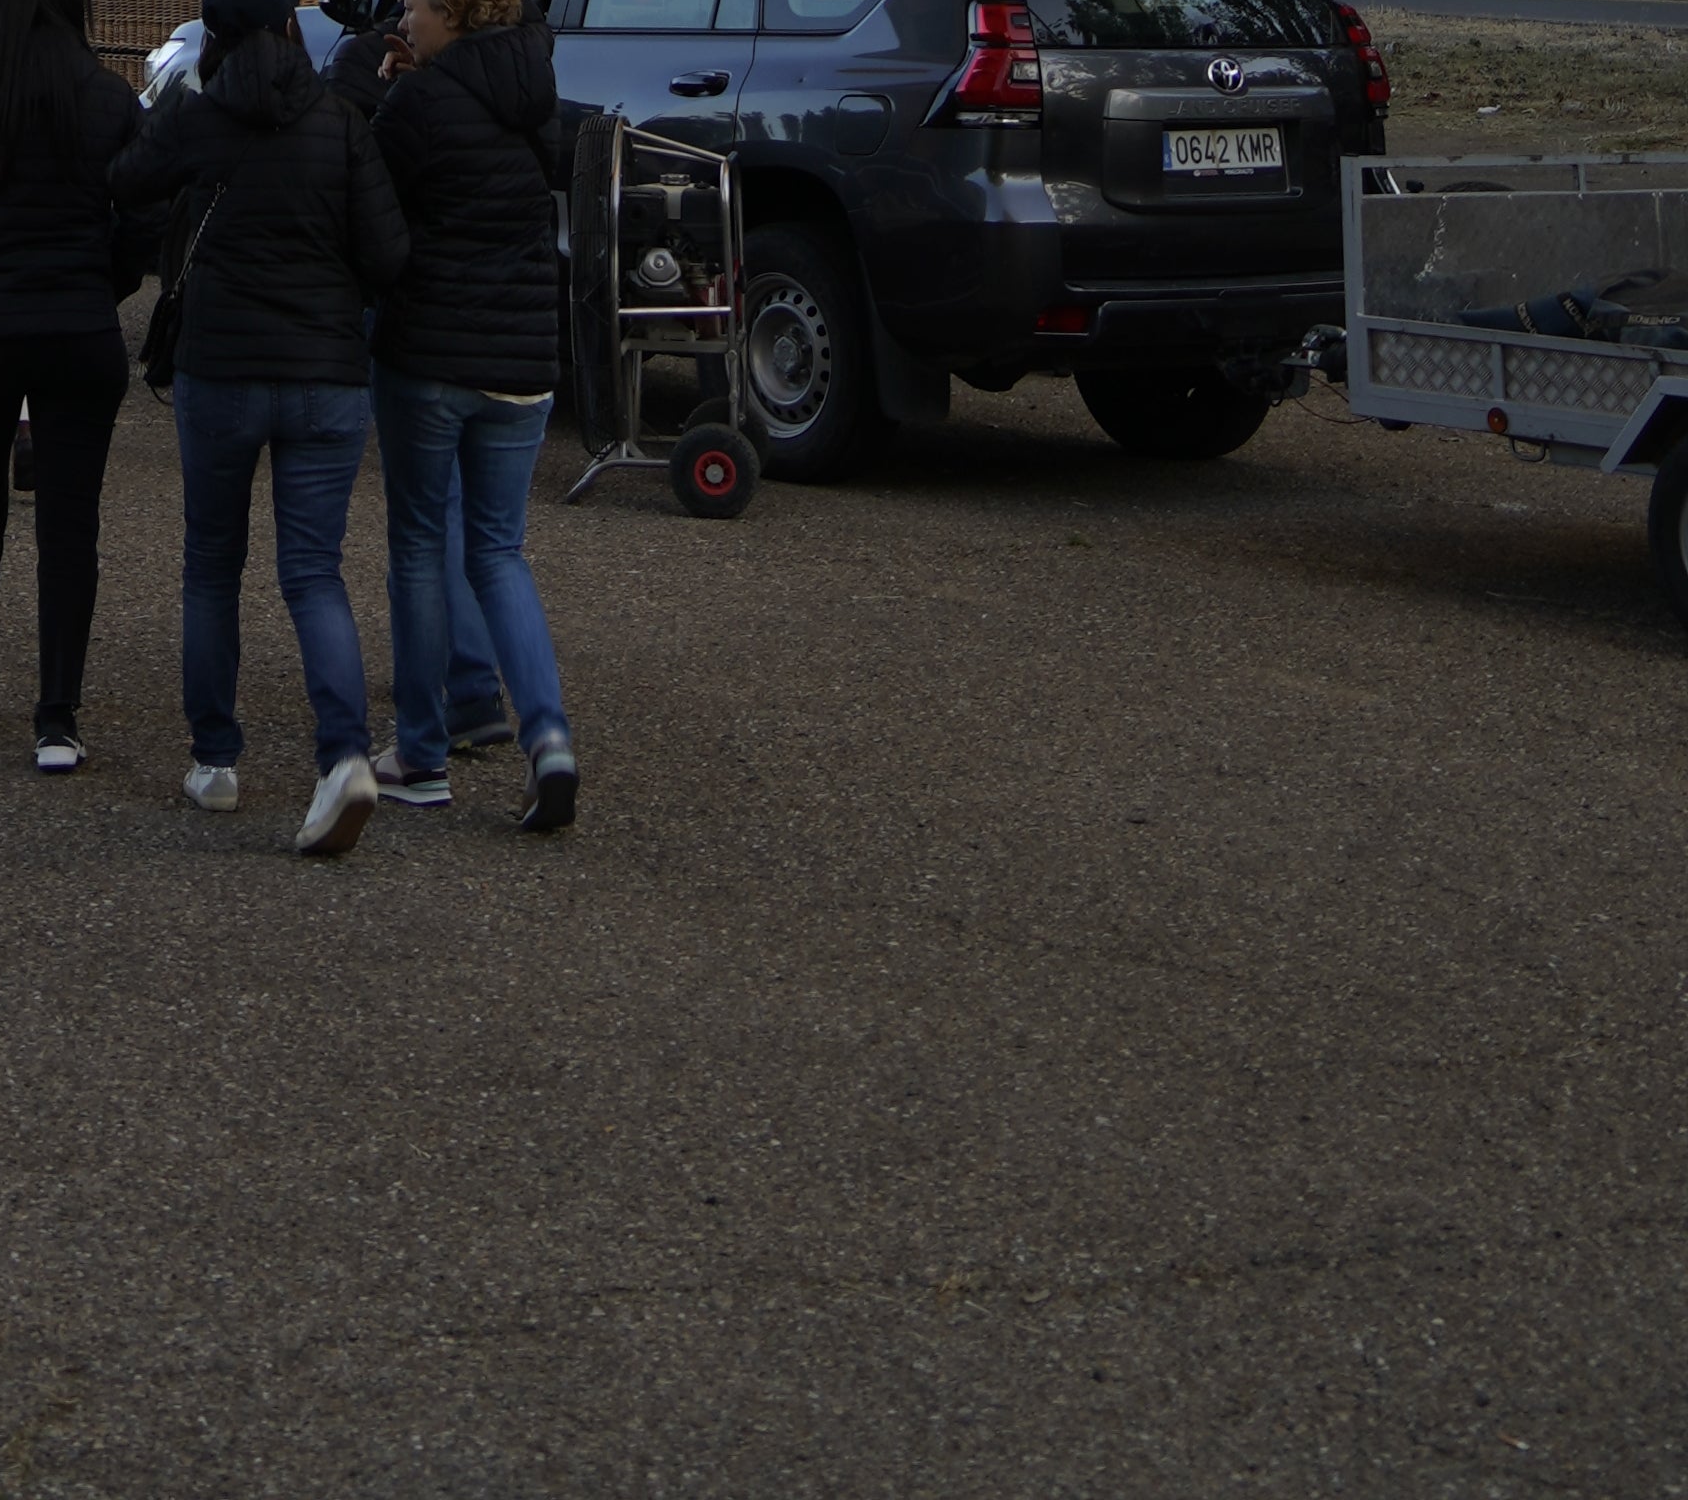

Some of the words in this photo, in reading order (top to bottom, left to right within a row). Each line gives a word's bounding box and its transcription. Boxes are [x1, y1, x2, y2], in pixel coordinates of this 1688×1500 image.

[1167, 100, 1216, 115] LAND
[1223, 97, 1301, 114] CRUISER
[1175, 135, 1230, 164] 0642
[1235, 133, 1276, 163] KMR
